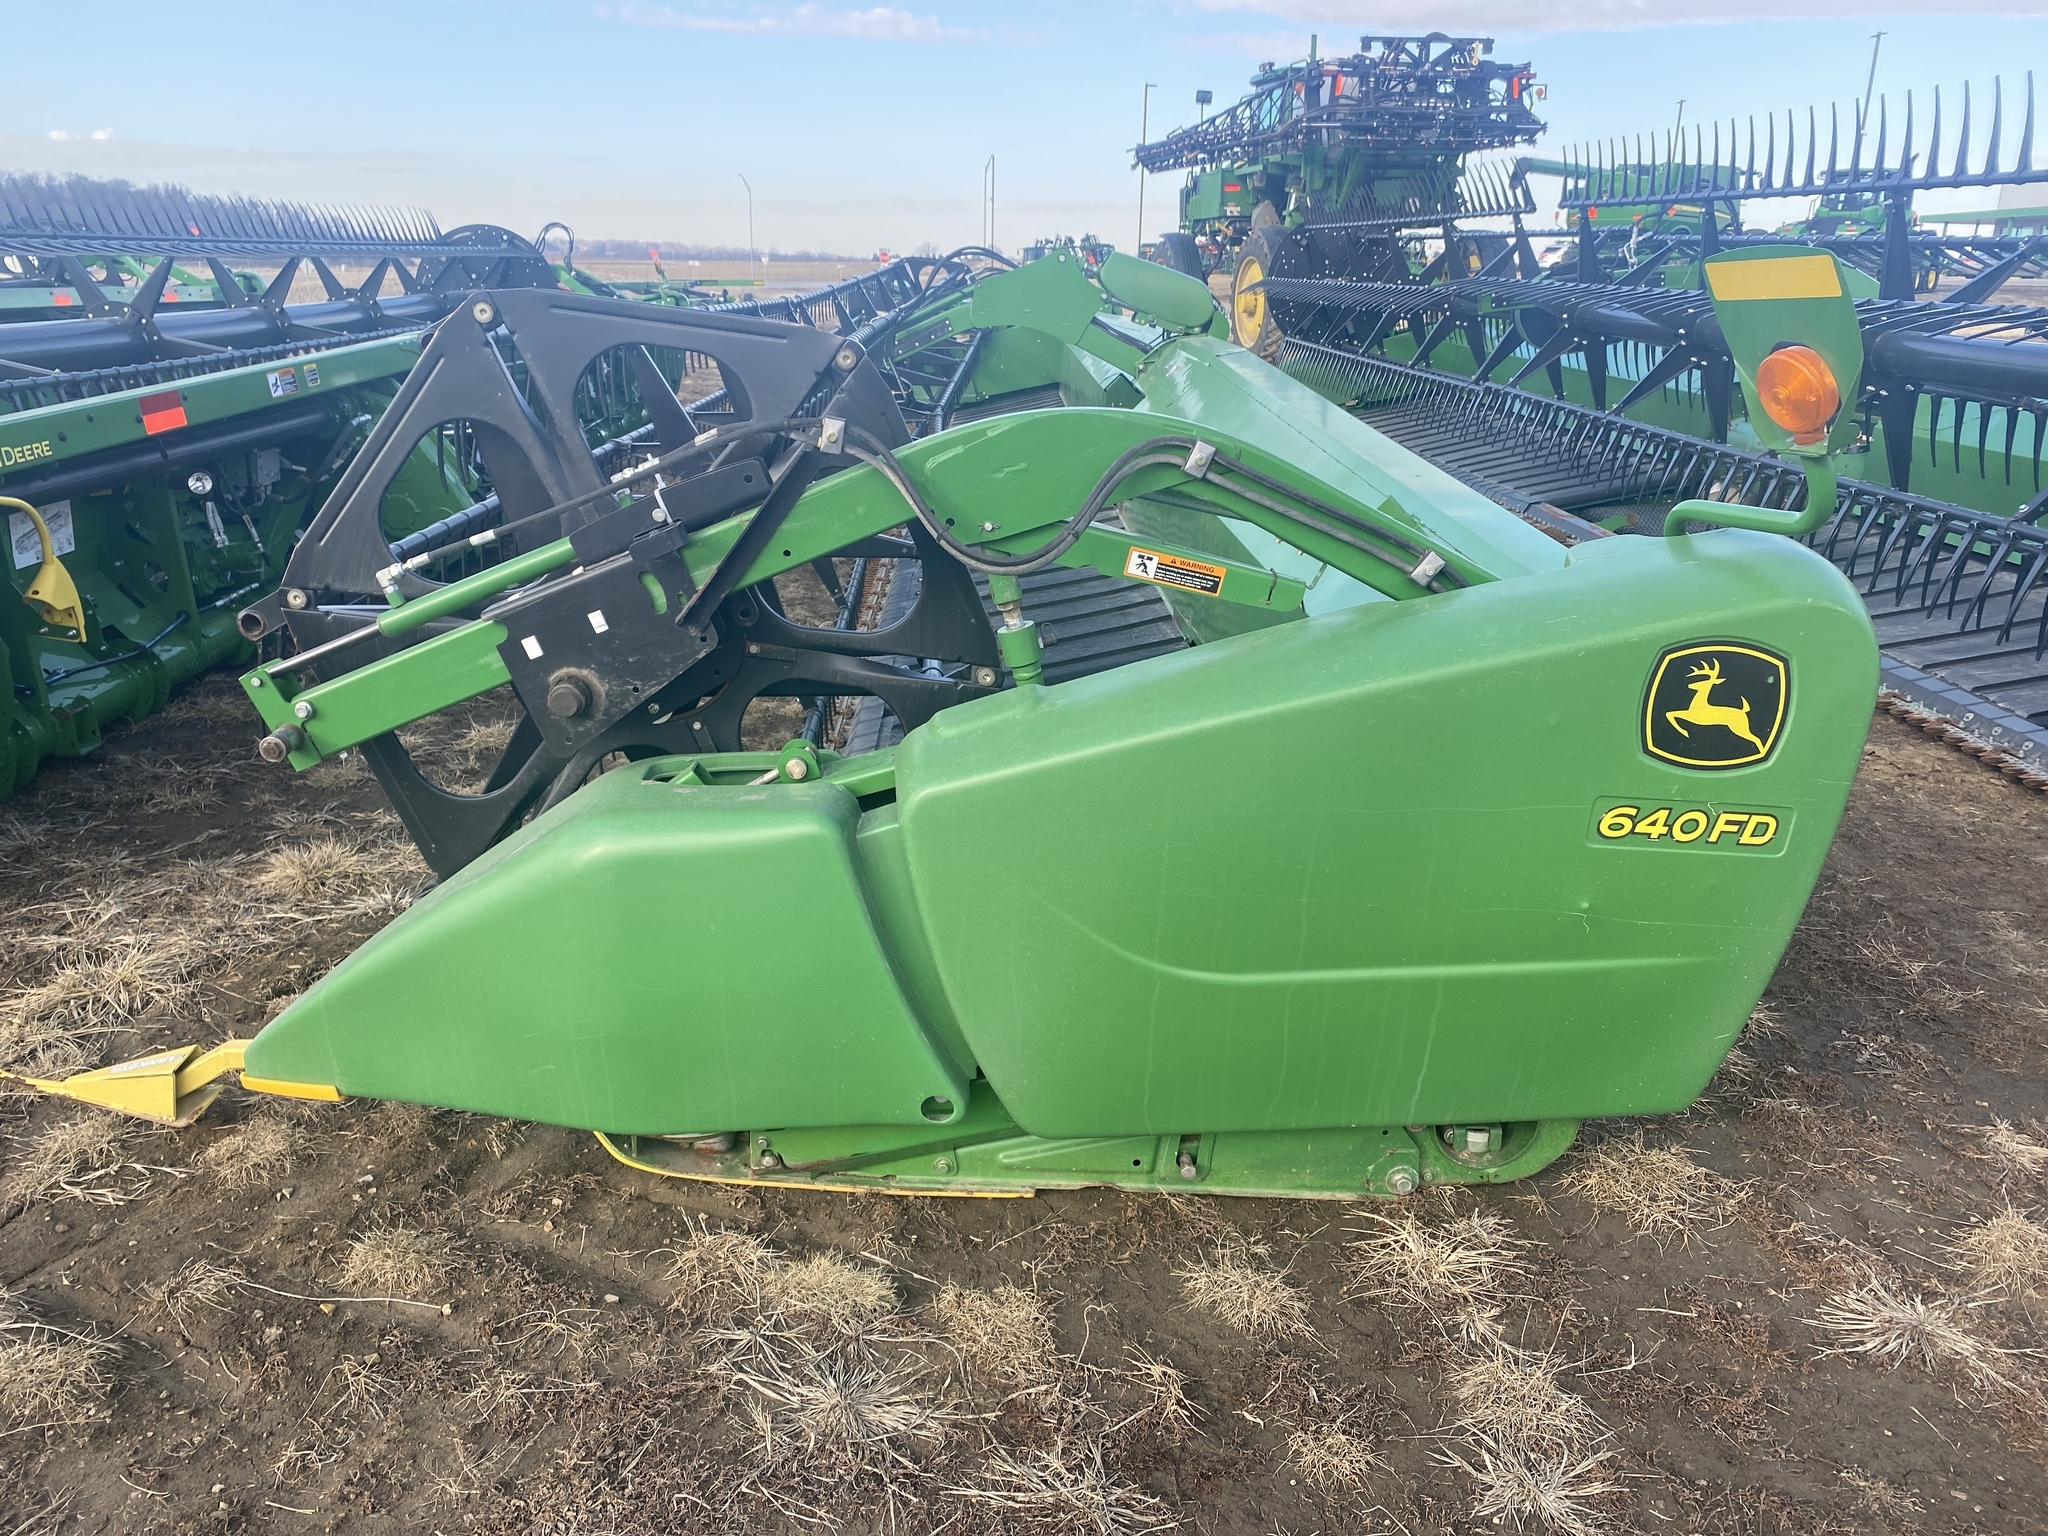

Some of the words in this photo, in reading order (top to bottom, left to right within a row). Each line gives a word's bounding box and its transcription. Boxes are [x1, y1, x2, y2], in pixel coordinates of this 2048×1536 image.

[1, 441, 53, 466] DEERE
[1180, 560, 1215, 573] WARNING
[1598, 805, 1779, 846] 640FD
